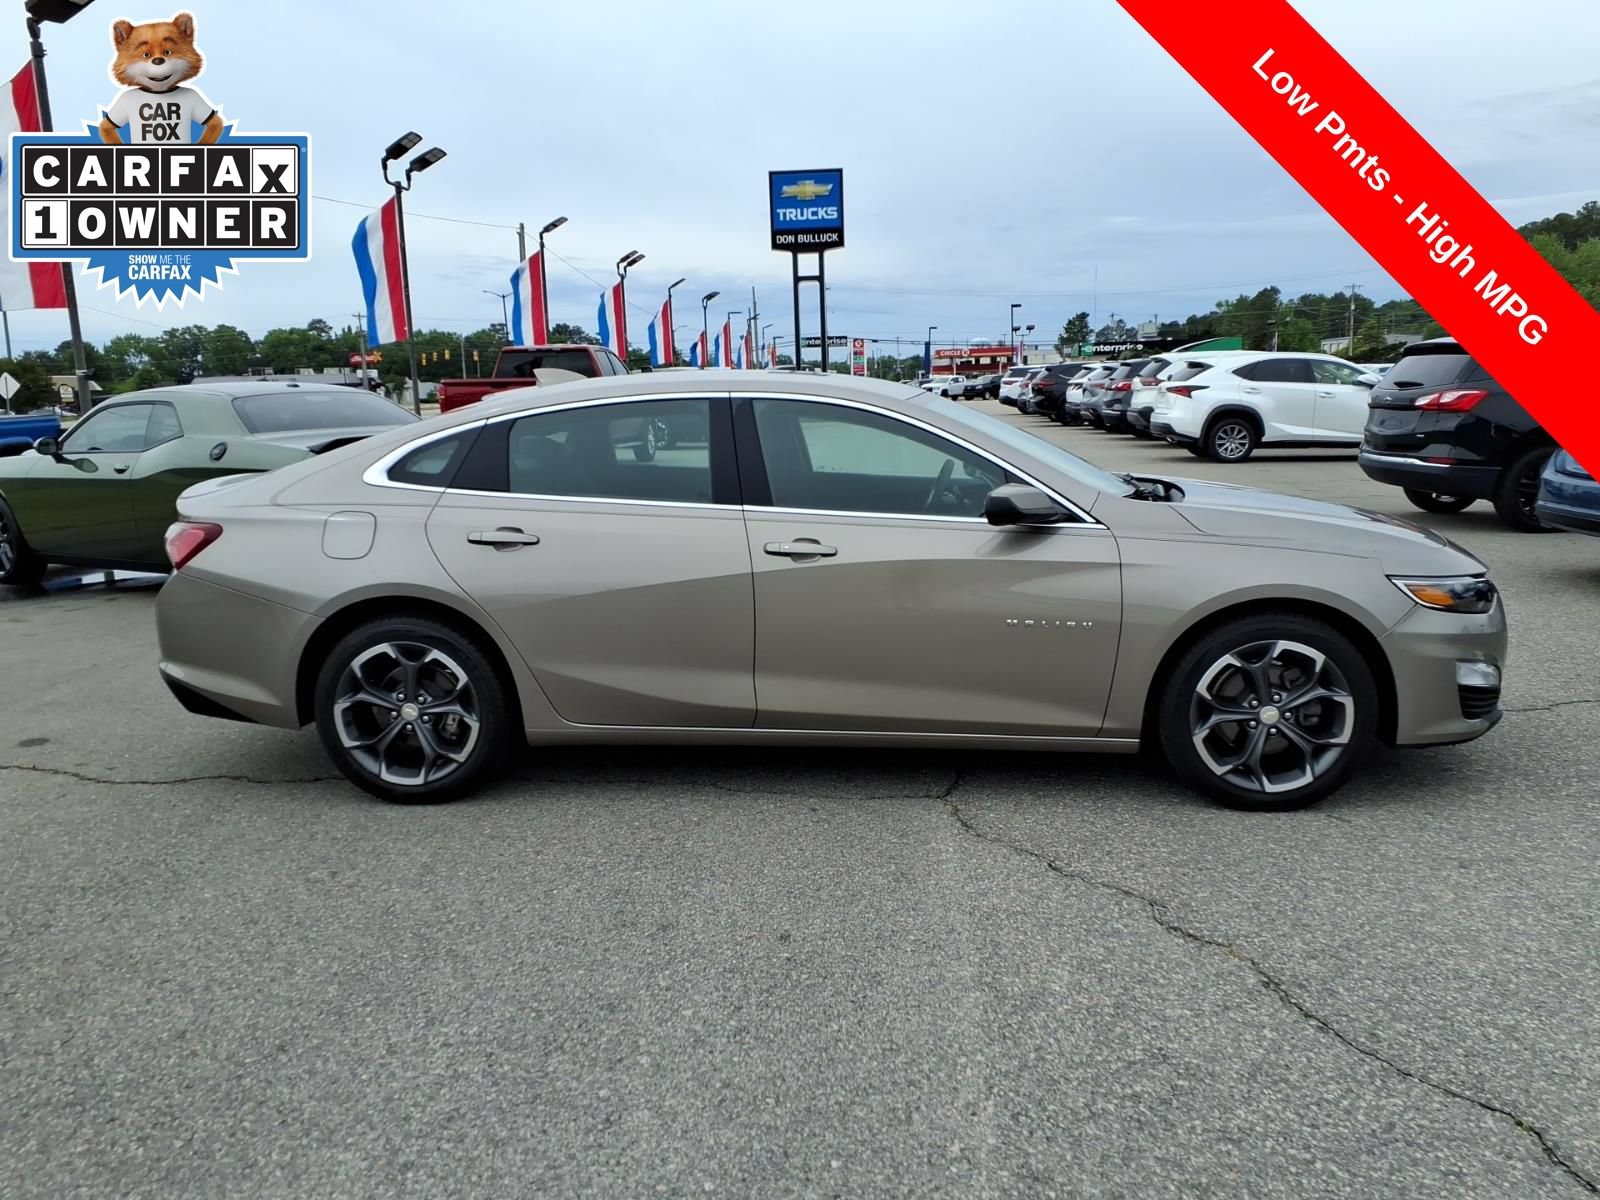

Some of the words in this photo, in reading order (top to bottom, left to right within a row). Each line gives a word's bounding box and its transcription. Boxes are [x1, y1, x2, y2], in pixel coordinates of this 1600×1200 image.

[777, 207, 838, 221] TRUCKS
[776, 235, 795, 244] DON
[797, 233, 839, 243] BULLUCK
